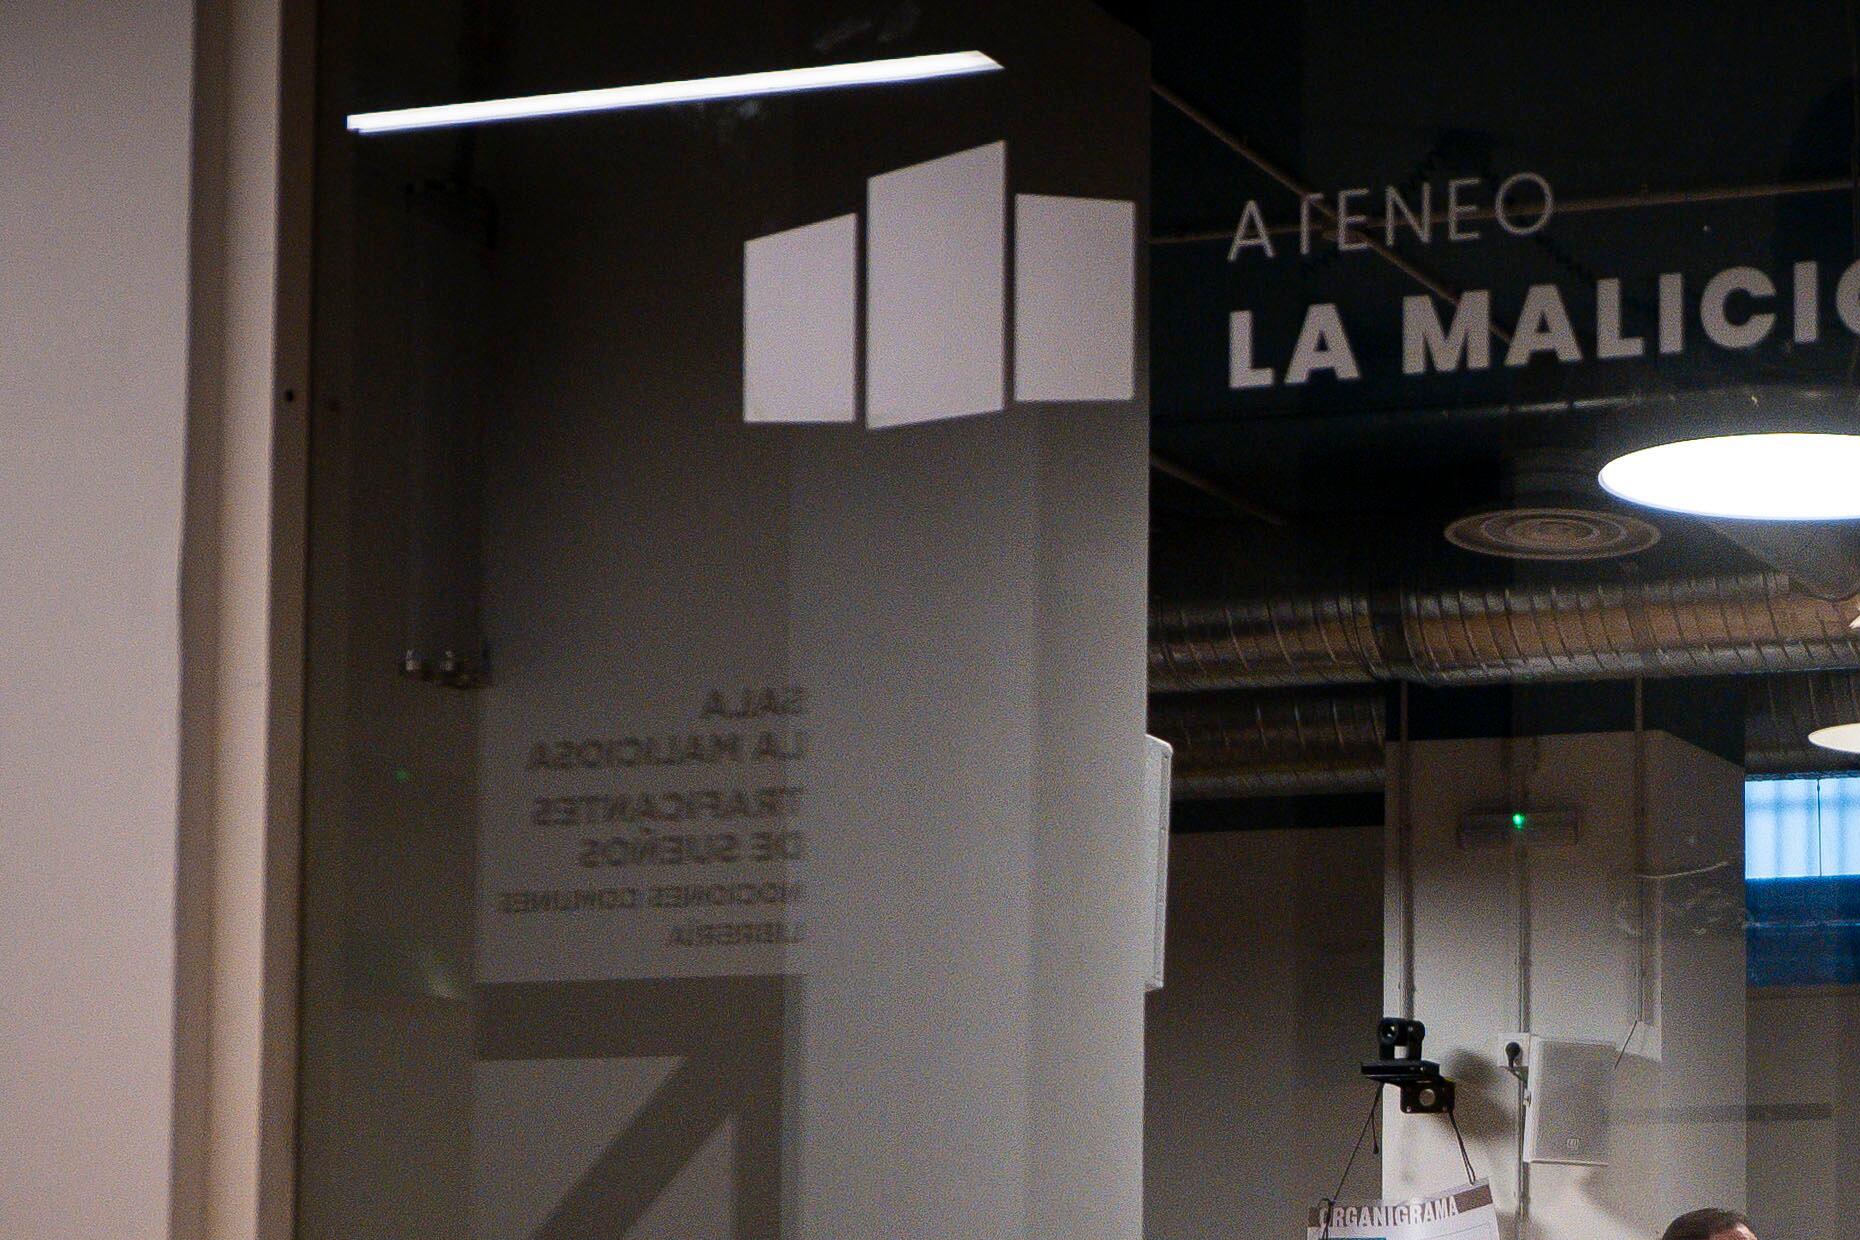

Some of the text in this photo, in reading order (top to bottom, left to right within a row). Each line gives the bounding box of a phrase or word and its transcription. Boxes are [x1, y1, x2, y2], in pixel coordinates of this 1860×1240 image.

[1227, 170, 1555, 262] ATENEO
[1228, 303, 1362, 390] LA
[1319, 1196, 1460, 1228] ORGANIGRAMA
